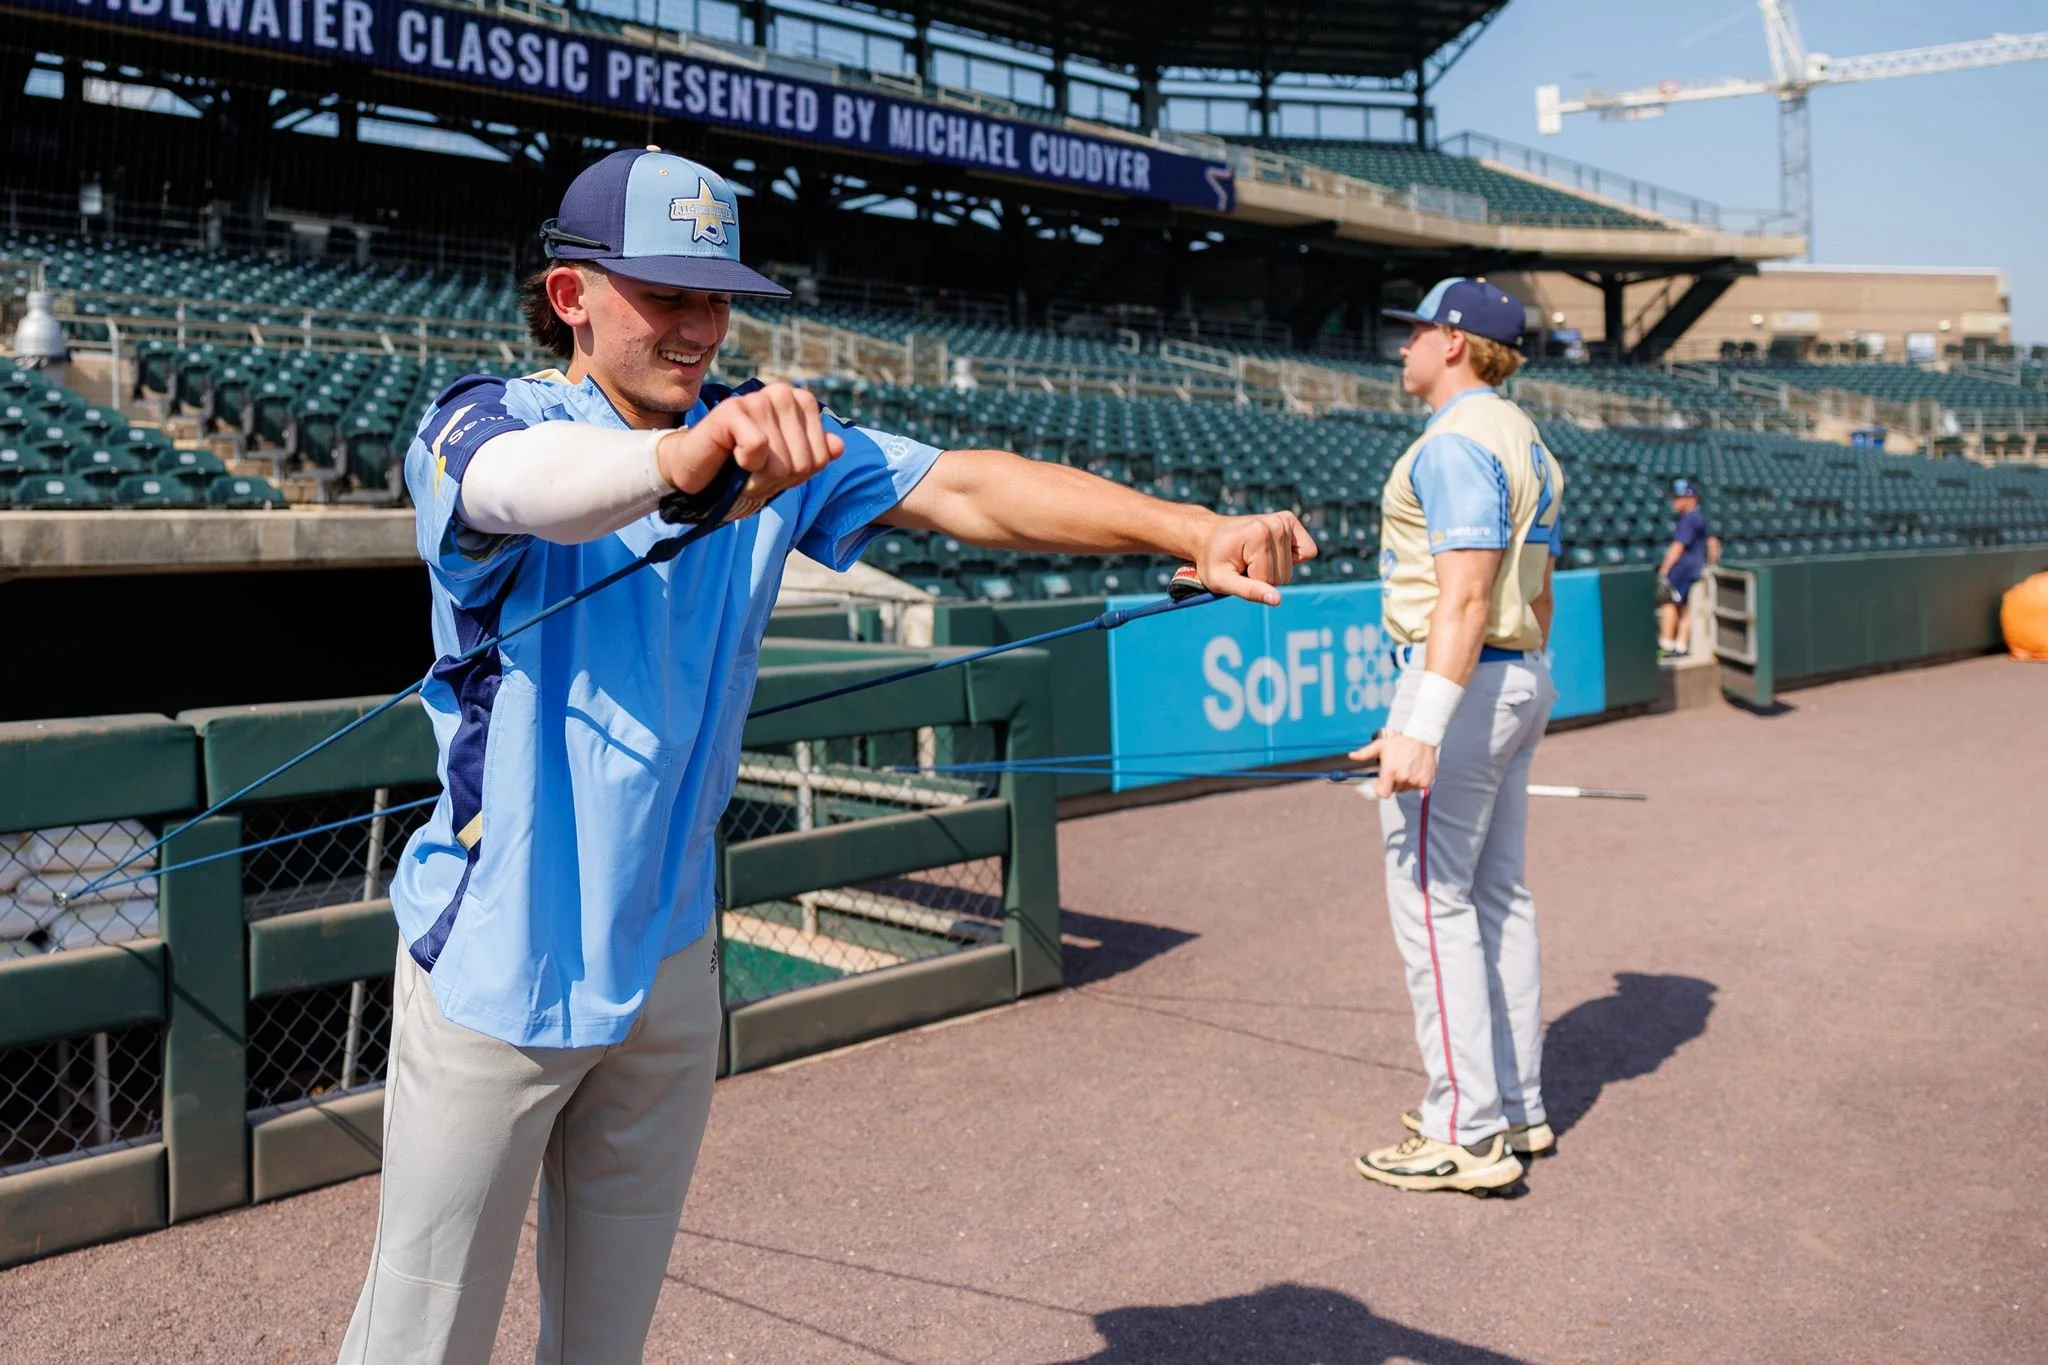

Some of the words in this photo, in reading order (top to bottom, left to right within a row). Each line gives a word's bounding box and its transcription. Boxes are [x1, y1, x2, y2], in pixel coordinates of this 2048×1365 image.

[79, 0, 373, 54] WATER
[398, 9, 589, 93] CLASSIC
[607, 50, 818, 132] PRESENTED
[833, 94, 875, 142] BY
[888, 104, 1020, 169] MICHAEL
[1030, 131, 1151, 191] CUDDYER
[1203, 627, 1336, 732] SoFi
